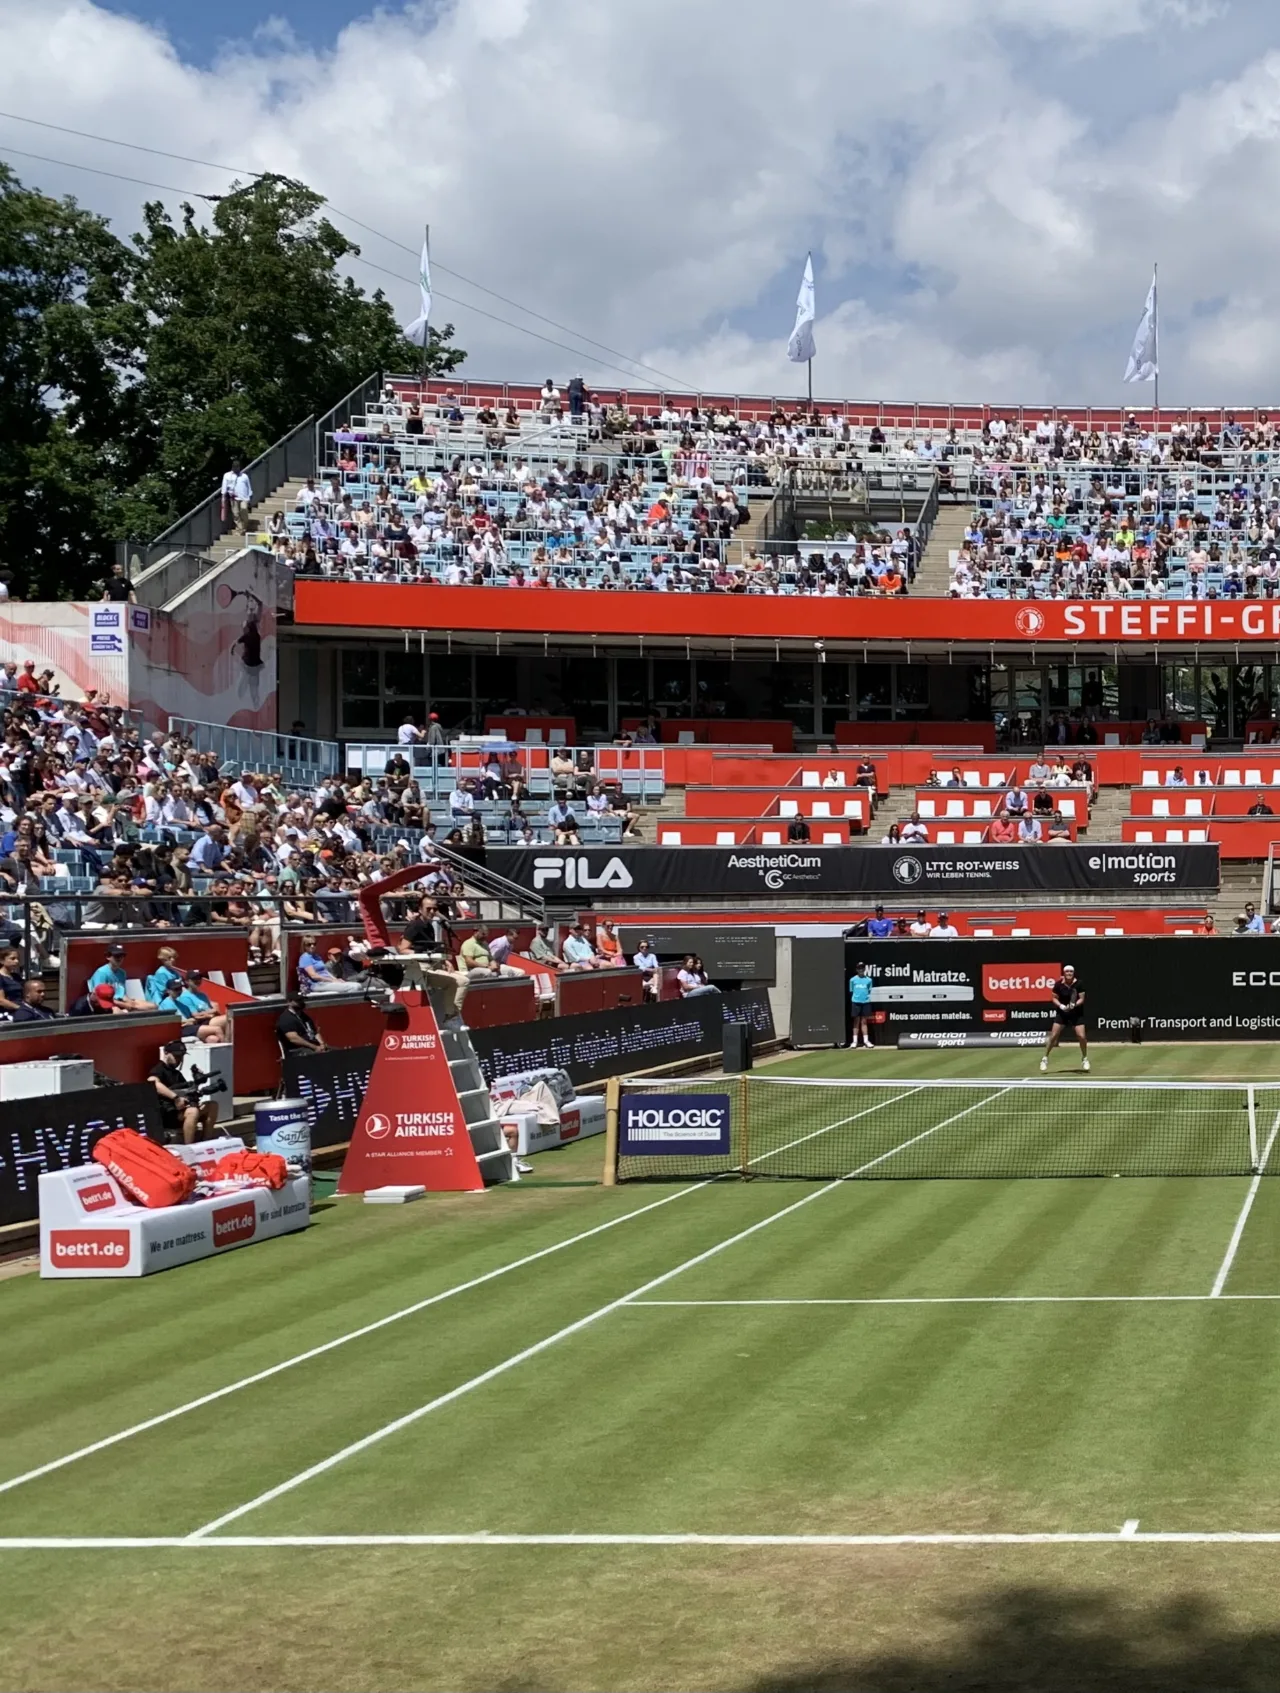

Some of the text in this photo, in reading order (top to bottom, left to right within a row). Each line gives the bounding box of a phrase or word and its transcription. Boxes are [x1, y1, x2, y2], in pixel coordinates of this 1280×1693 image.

[727, 854, 821, 868] AesthetiCum
[925, 861, 954, 871] LTTC
[956, 860, 1020, 871] ROT-WEISS
[533, 857, 633, 889] FILA
[965, 871, 992, 879] TENNIS.
[1133, 870, 1176, 885] sports
[884, 963, 910, 977] sind
[912, 970, 970, 983] Matratze.
[988, 975, 1056, 990] bett1.de
[889, 1012, 908, 1021] Nous
[909, 1012, 940, 1021] sommes
[941, 1011, 973, 1020] matelas.
[1010, 1010, 1040, 1019] Materac
[1040, 1010, 1049, 1019] to
[1148, 1016, 1208, 1030] Transport
[1209, 1015, 1232, 1028] and
[401, 1034, 436, 1042] TURKISH
[937, 1039, 966, 1048] sports
[1017, 1036, 1047, 1047] sports
[401, 1041, 436, 1050] AIRLINES
[268, 1114, 289, 1122] Taste
[289, 1112, 301, 1120] the
[395, 1112, 454, 1125] TURKISH
[627, 1108, 722, 1128] HOLOGIC
[394, 1124, 455, 1138] AIRLINES
[107, 1160, 150, 1202] Wilson
[82, 1190, 113, 1206] bett1.de
[215, 1214, 253, 1236] bett1.de
[55, 1240, 126, 1257] bett1.de
[150, 1231, 207, 1253] We are mattress.
